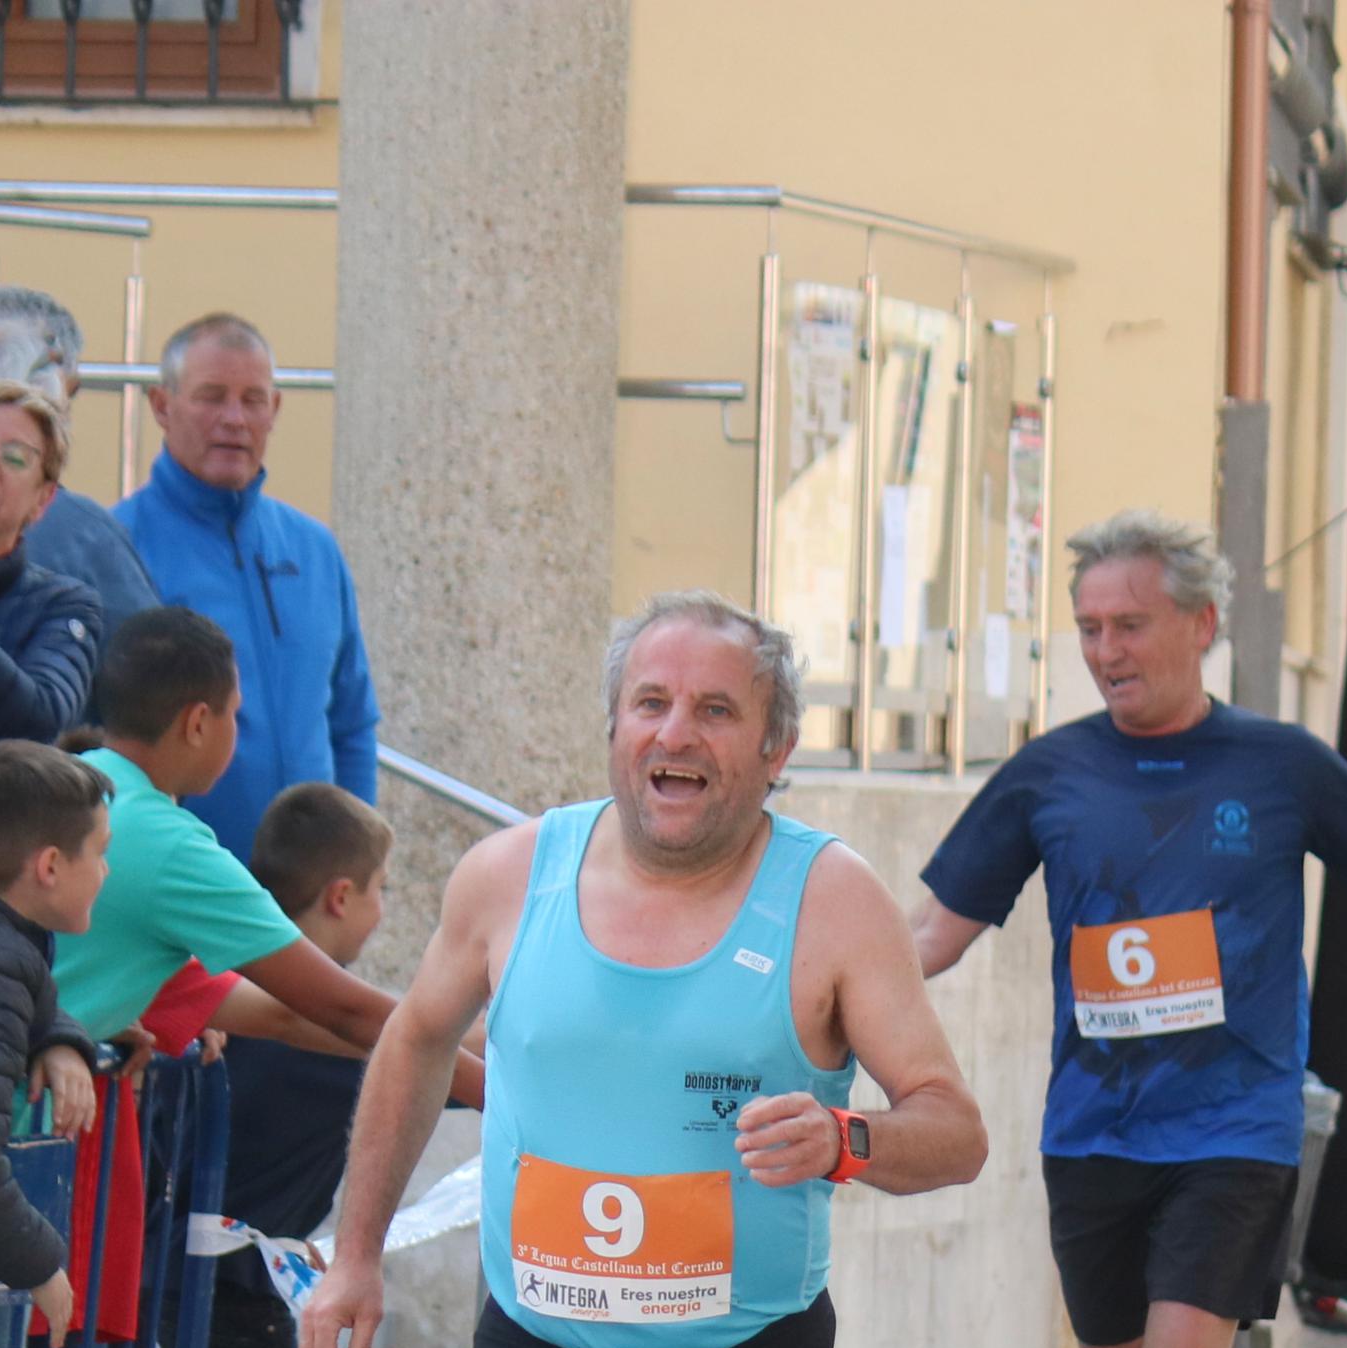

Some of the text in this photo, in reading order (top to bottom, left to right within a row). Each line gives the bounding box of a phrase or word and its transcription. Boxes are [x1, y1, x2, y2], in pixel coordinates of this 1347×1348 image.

[1107, 926, 1156, 986] 6
[582, 1181, 645, 1258] 9
[531, 1246, 568, 1268] Legua
[571, 1256, 643, 1275] Castellana
[647, 1261, 666, 1275] del
[671, 1260, 724, 1275] Cerrato
[545, 1281, 609, 1309] INTEGRA
[620, 1286, 717, 1302] Eres nuestra
